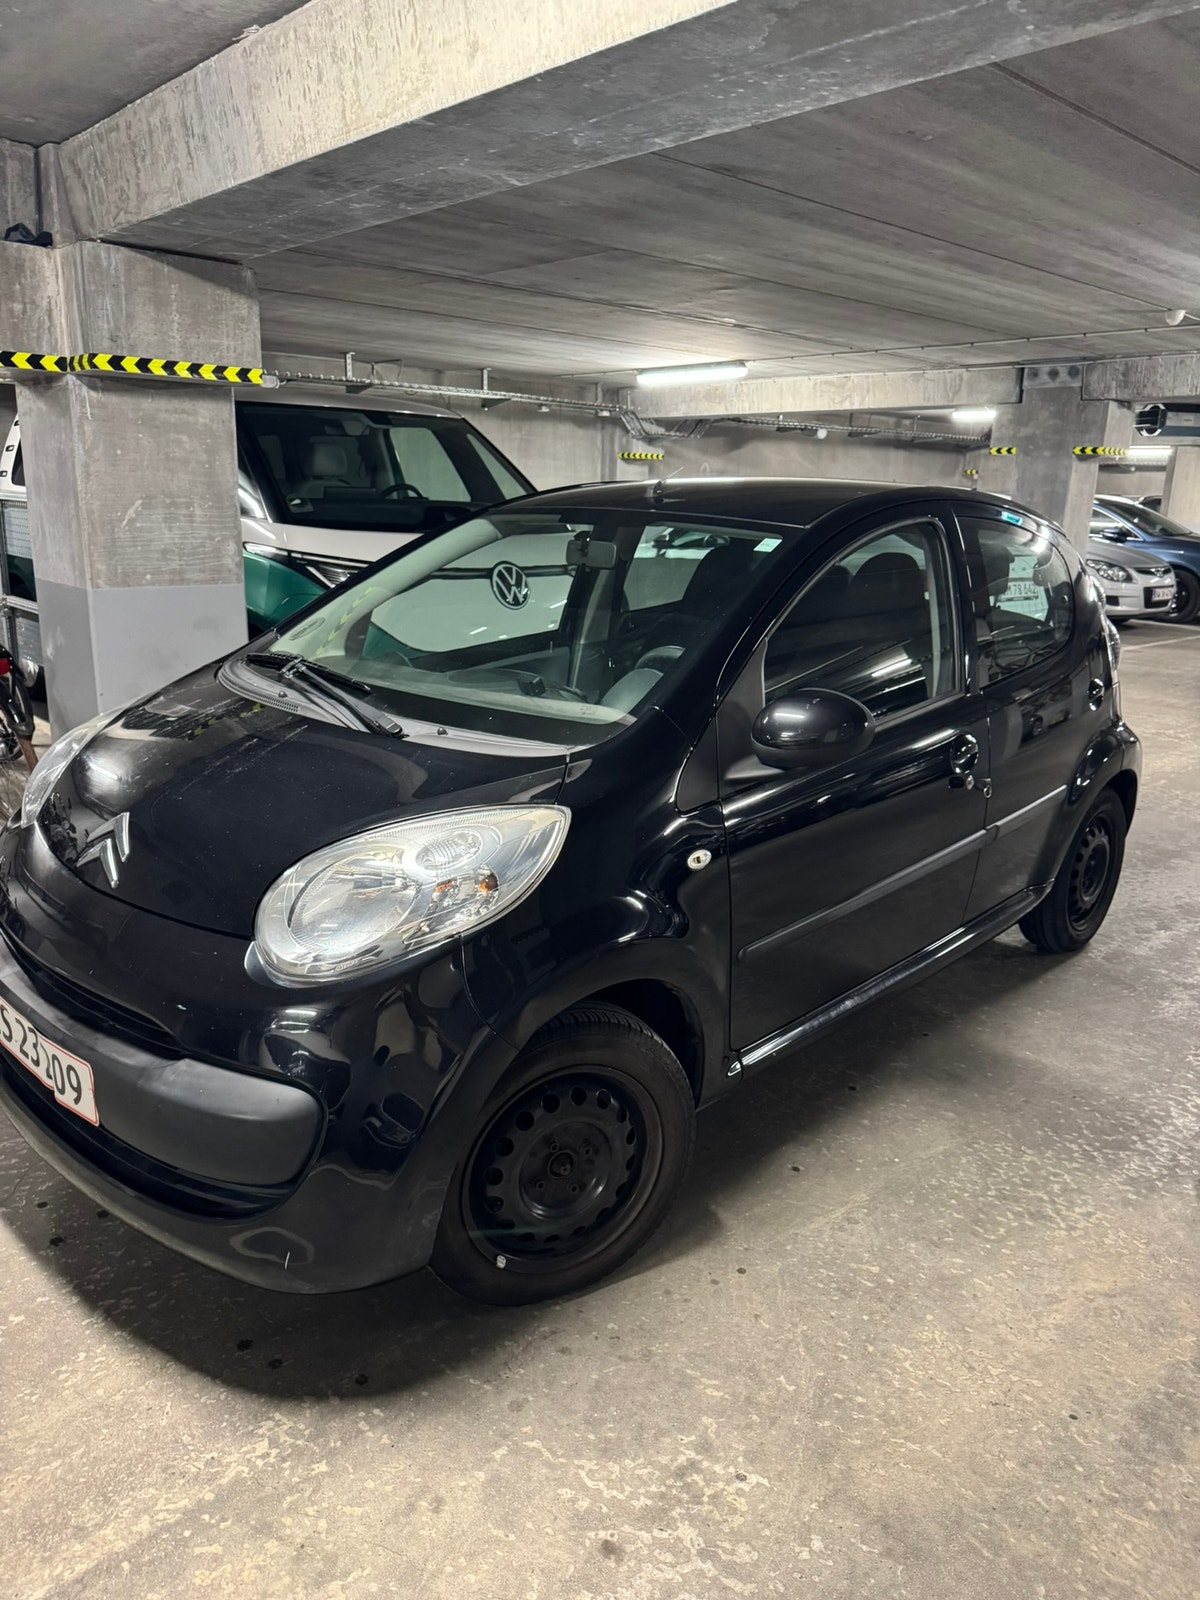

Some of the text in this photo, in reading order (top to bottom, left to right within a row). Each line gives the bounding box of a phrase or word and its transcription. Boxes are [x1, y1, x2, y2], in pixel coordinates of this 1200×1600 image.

[1012, 583, 1023, 595] 78
[0, 1003, 13, 1043] S
[14, 1016, 41, 1068] 23
